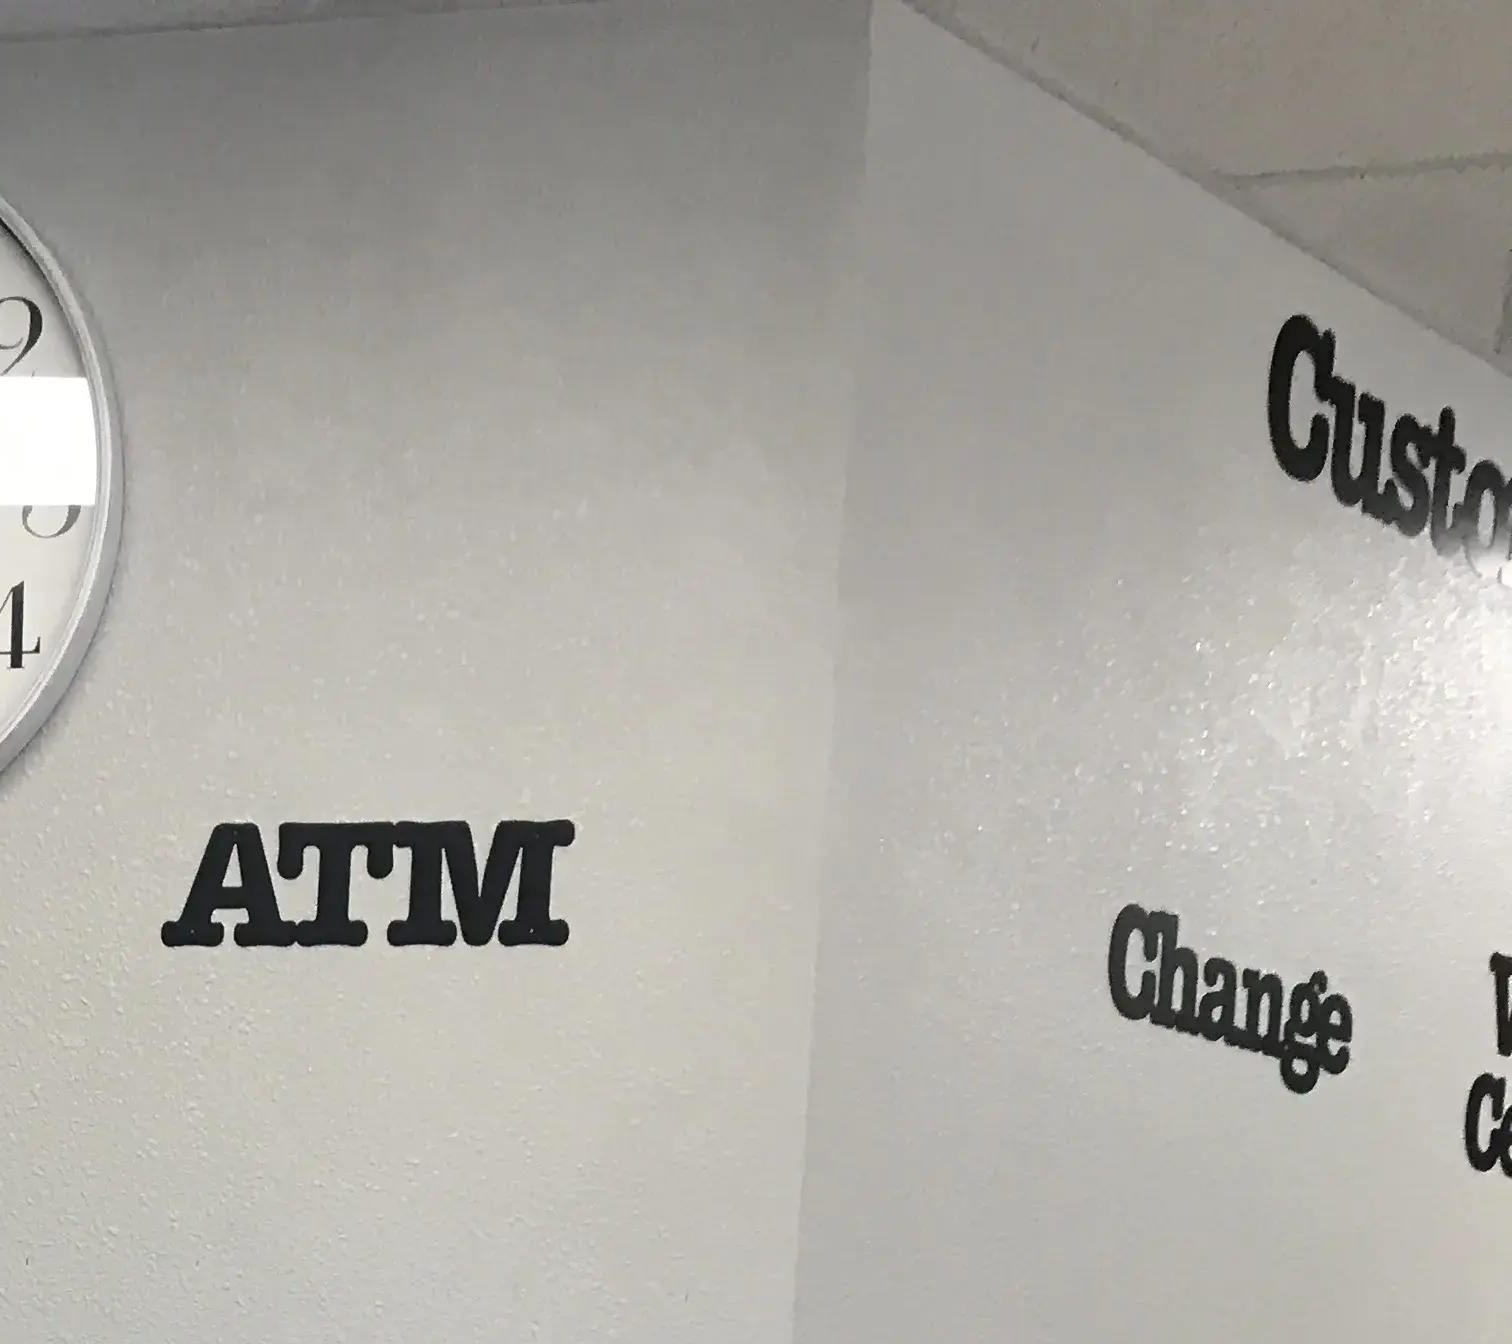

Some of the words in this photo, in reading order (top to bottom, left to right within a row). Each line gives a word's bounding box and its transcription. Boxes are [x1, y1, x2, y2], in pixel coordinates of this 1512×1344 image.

[1267, 314, 1512, 590] Custo
[161, 819, 576, 947] ATM
[1107, 902, 1354, 1095] Change
